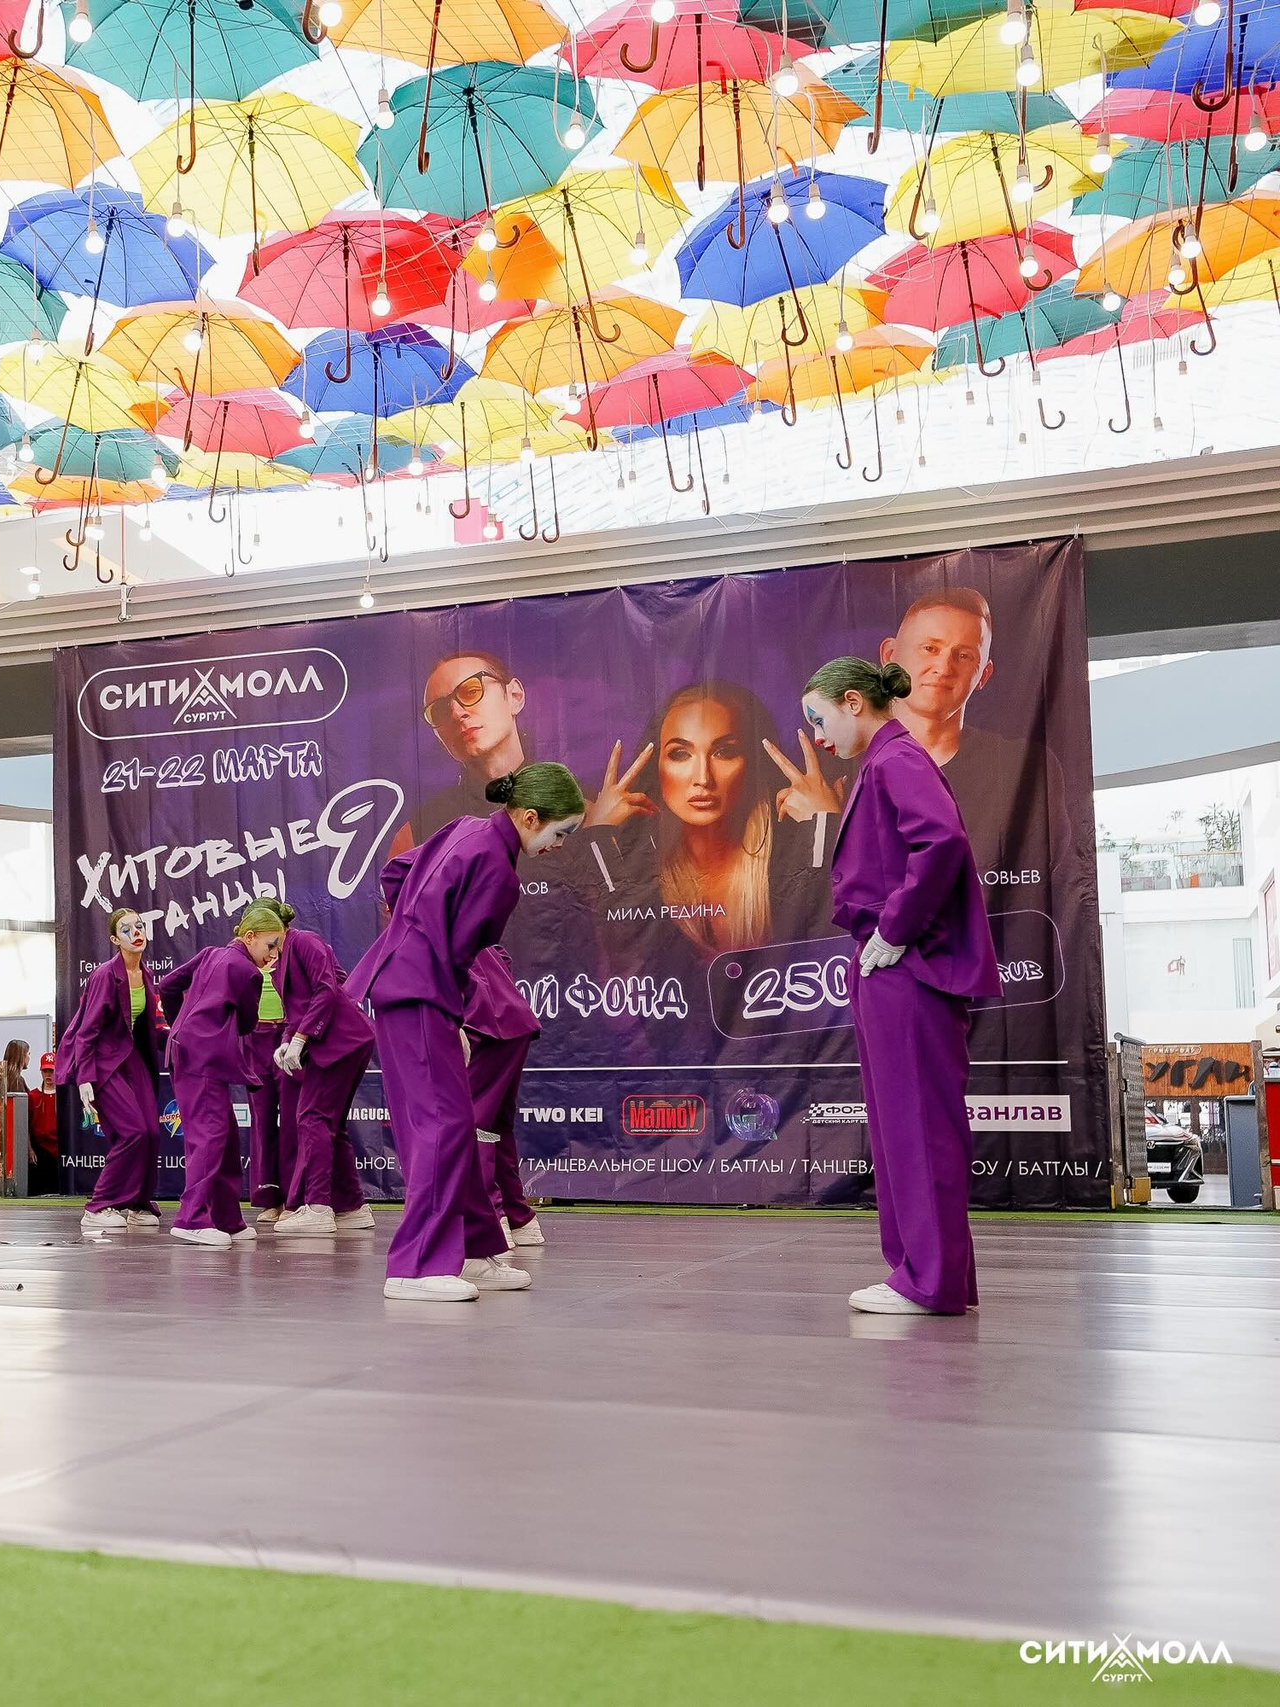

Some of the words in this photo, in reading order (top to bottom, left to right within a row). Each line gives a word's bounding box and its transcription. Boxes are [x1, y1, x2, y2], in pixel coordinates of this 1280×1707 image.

[99, 677, 190, 711] СИТИ
[220, 665, 324, 699] МОЛЛ
[183, 710, 227, 724] СУРГУТ
[101, 754, 206, 793] 21-22
[212, 740, 322, 784] МАРТА
[976, 869, 1041, 885] ОВЬЕВ
[607, 907, 656, 922] МИЛА
[660, 904, 726, 920] РЕДИНА
[565, 973, 688, 1020] ФОНД
[519, 1107, 566, 1122] TWO
[571, 1107, 603, 1122] KEI
[61, 1155, 106, 1169] ТАНЦЕВ
[165, 1155, 187, 1169] ШО
[527, 1158, 656, 1173] ТАНЦЕВАЛЬНОЕ
[660, 1158, 703, 1173] ШОУ
[720, 1159, 784, 1174] БАТТЛЫ
[971, 1160, 999, 1176] ОУ
[1018, 1161, 1088, 1176] БАТТЛЫ
